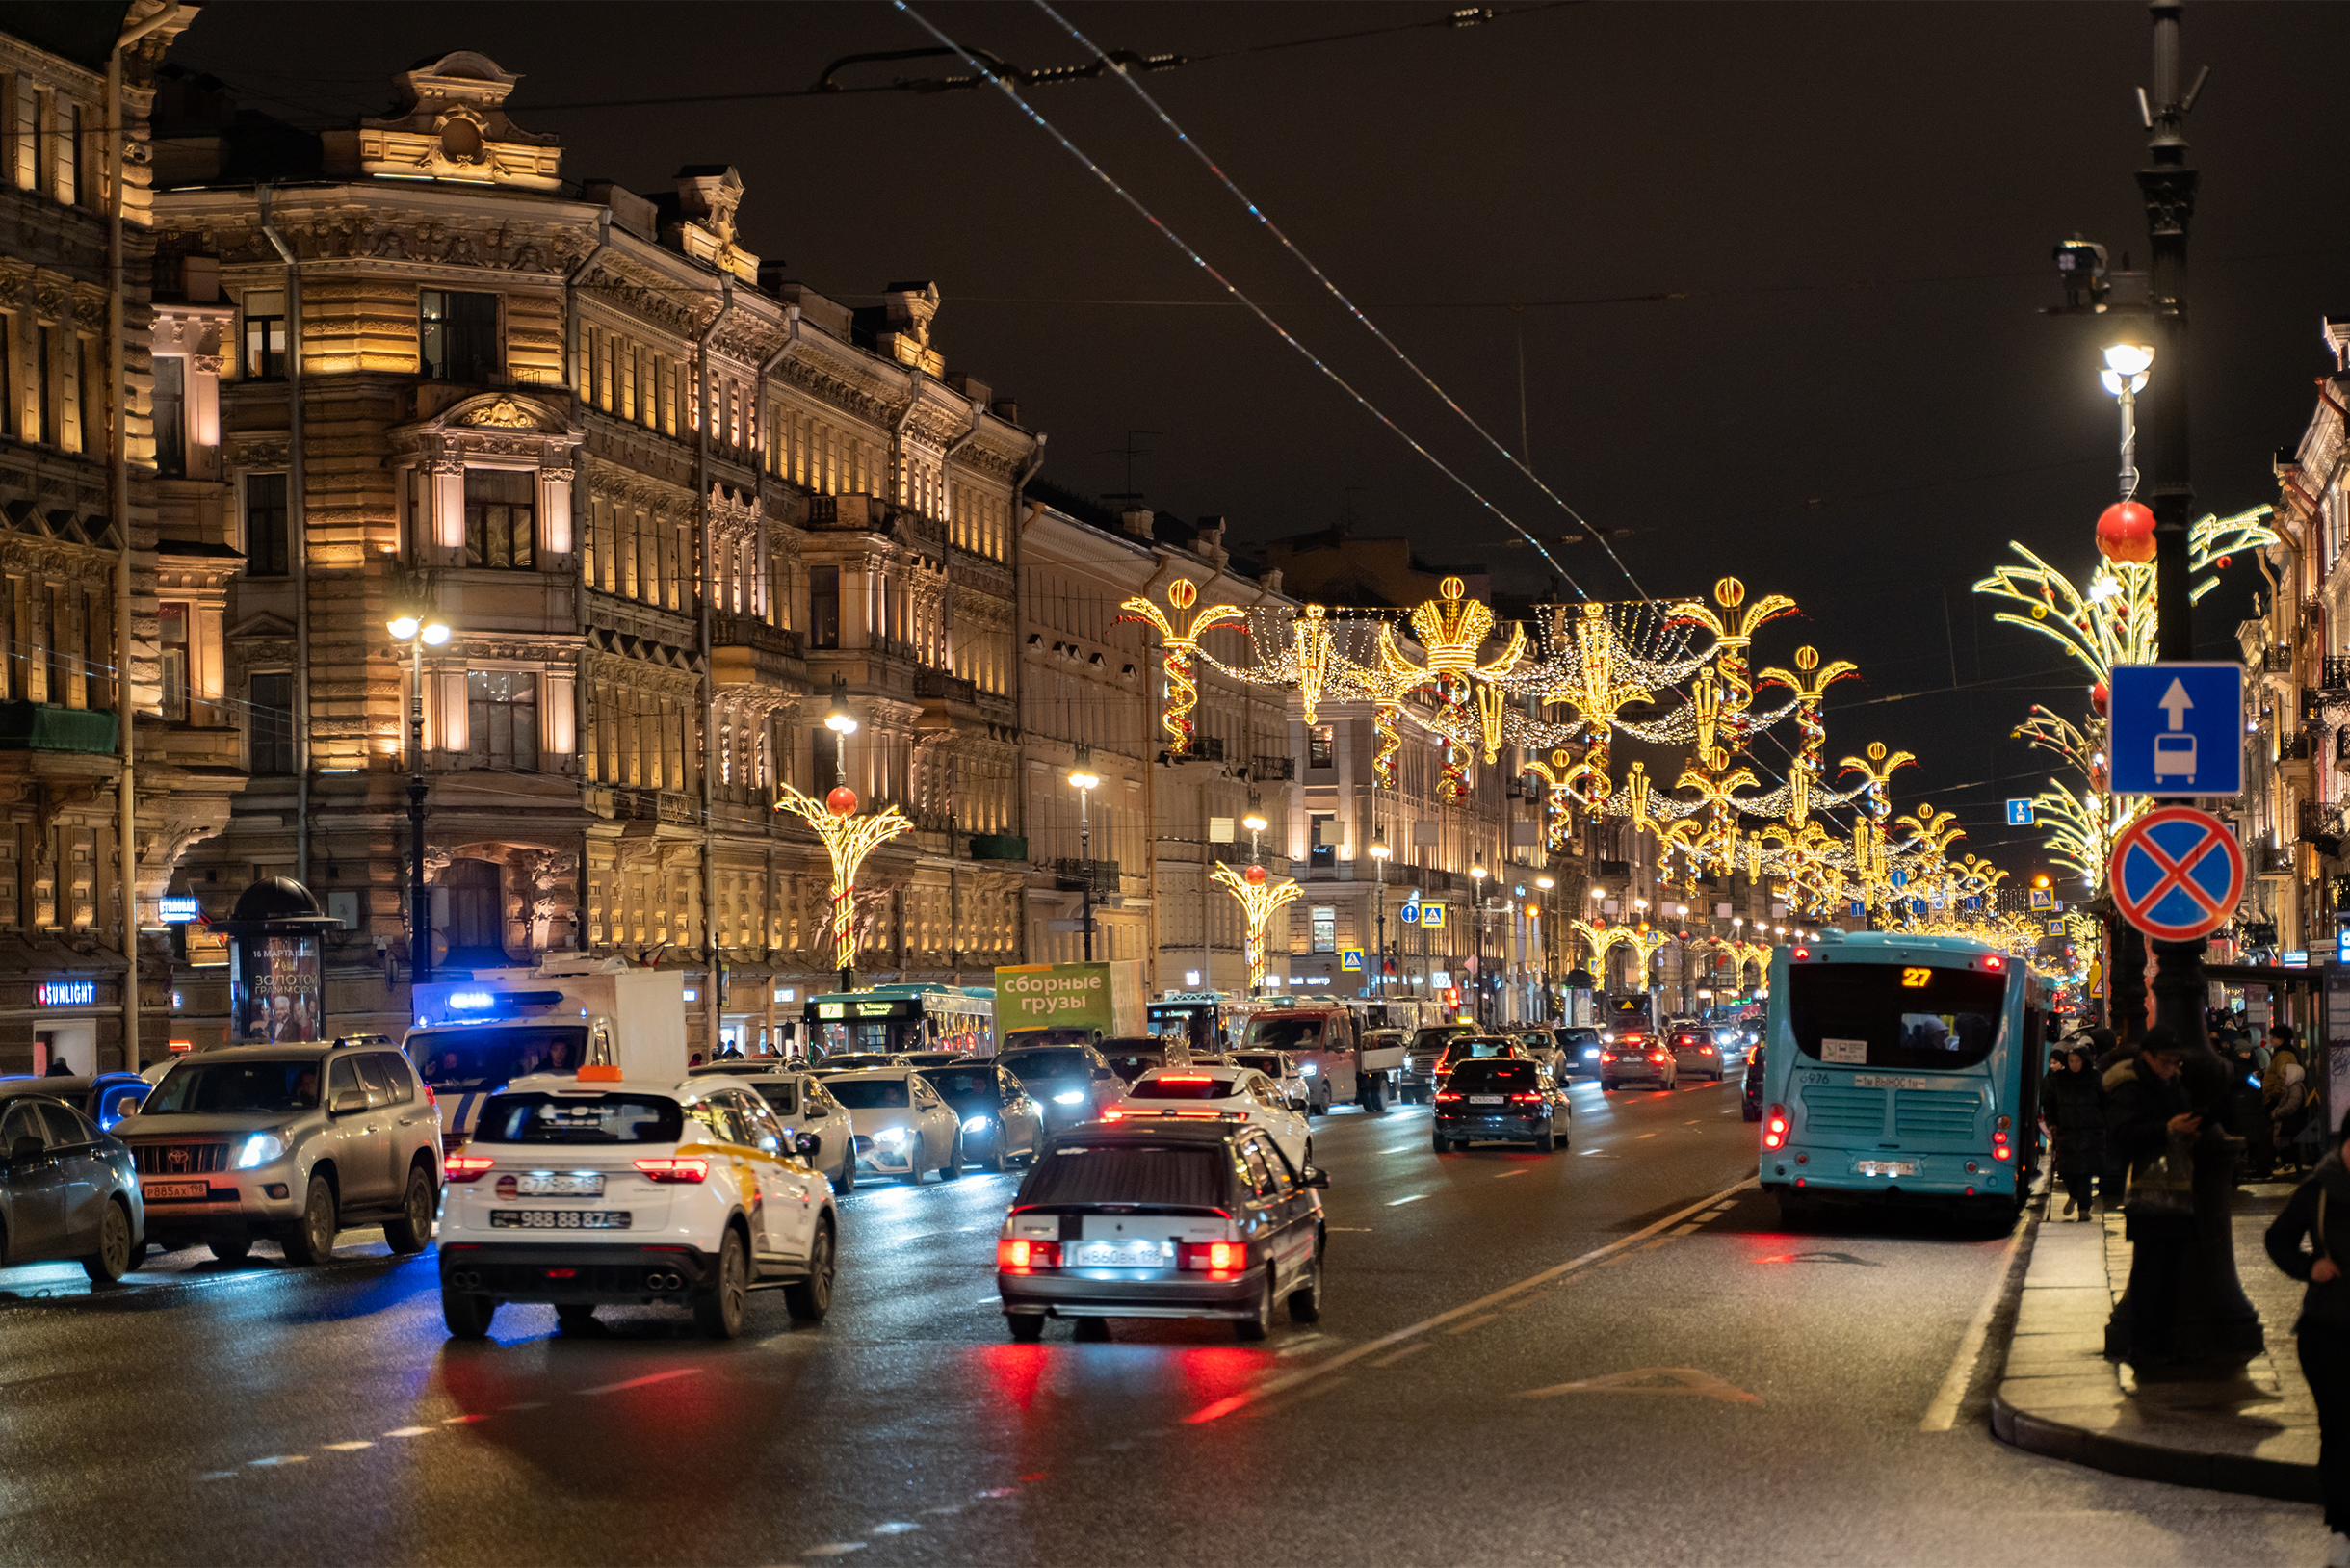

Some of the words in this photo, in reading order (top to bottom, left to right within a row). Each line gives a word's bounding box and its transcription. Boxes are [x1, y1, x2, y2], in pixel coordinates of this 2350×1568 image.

[255, 974, 318, 986] ЗОЛОТОЙ
[1902, 967, 1932, 987] 27
[46, 981, 95, 1006] SUNLIGHT
[1005, 975, 1102, 996] сборные
[1021, 995, 1086, 1015] грузы
[1875, 1076, 1906, 1088] ВЫНОС
[147, 1186, 187, 1197] Р885АХ
[190, 1184, 204, 1193] 198
[521, 1211, 555, 1227] 988
[558, 1211, 581, 1227] 88
[583, 1211, 606, 1227] 87
[1081, 1249, 1136, 1264] Н860ВН
